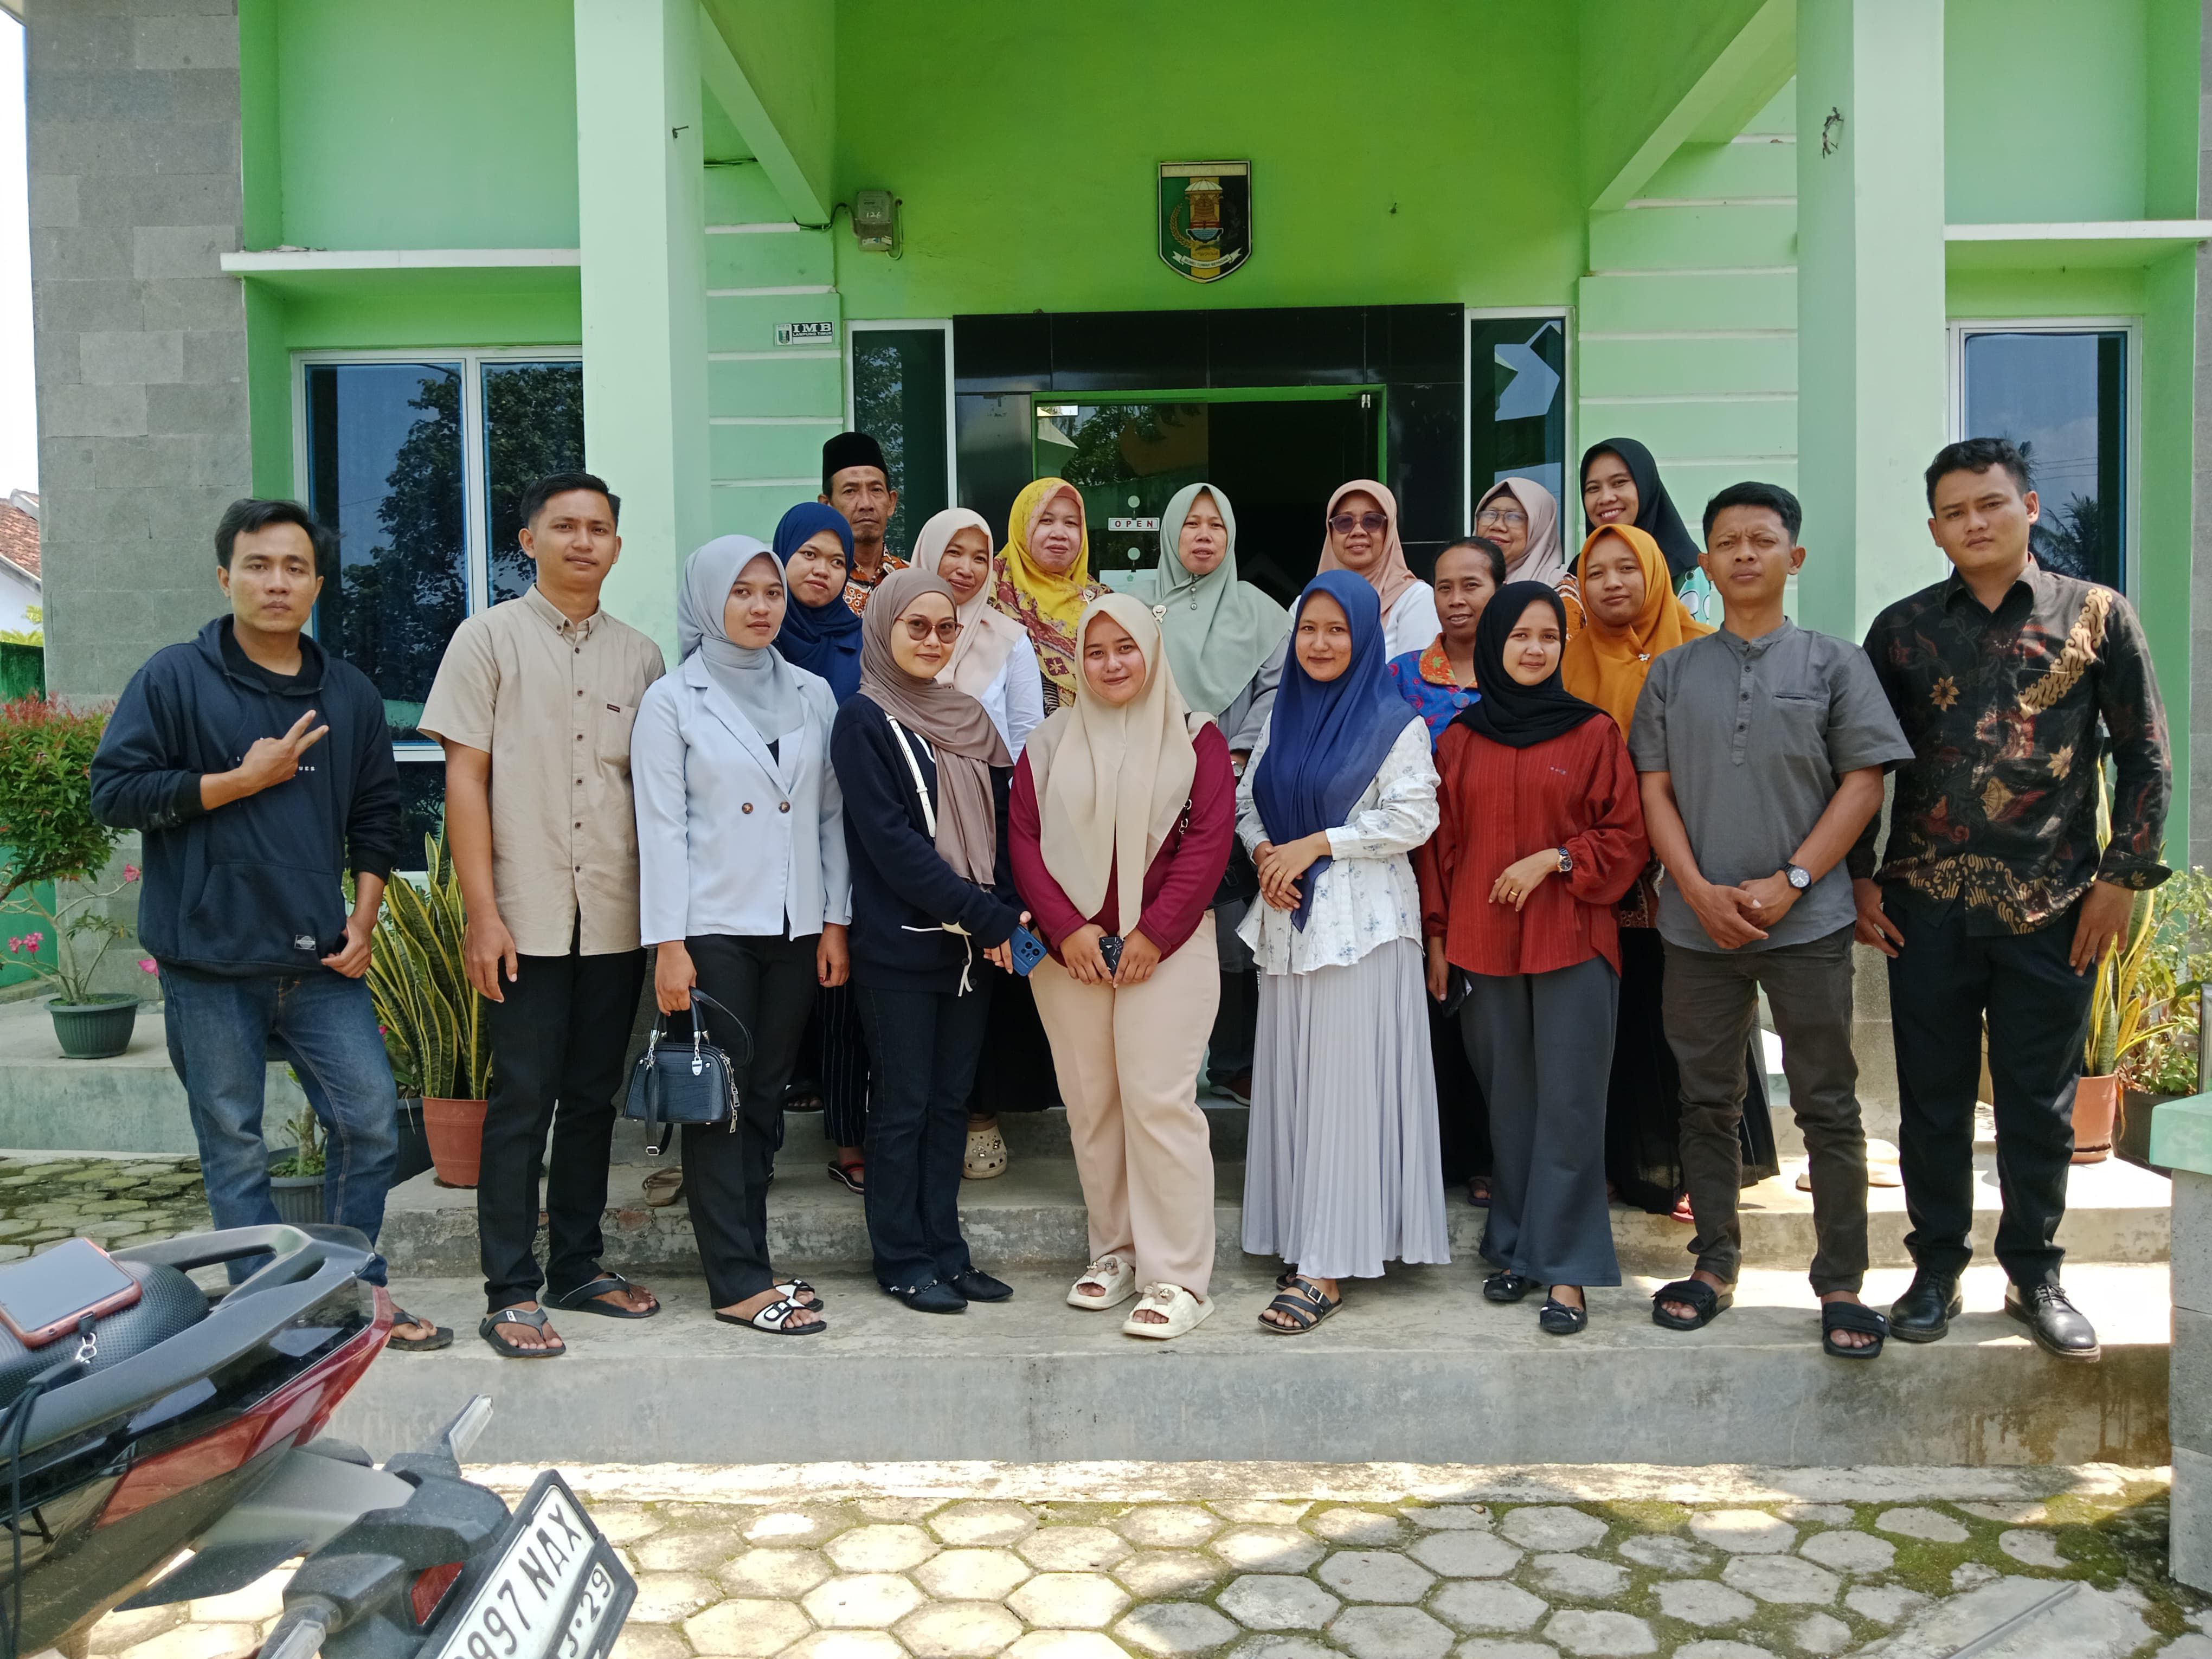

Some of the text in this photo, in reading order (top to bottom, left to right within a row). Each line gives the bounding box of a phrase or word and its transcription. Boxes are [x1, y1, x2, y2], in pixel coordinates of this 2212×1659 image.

[793, 323, 832, 332] IMB
[454, 1503, 582, 1659] 997 NAX
